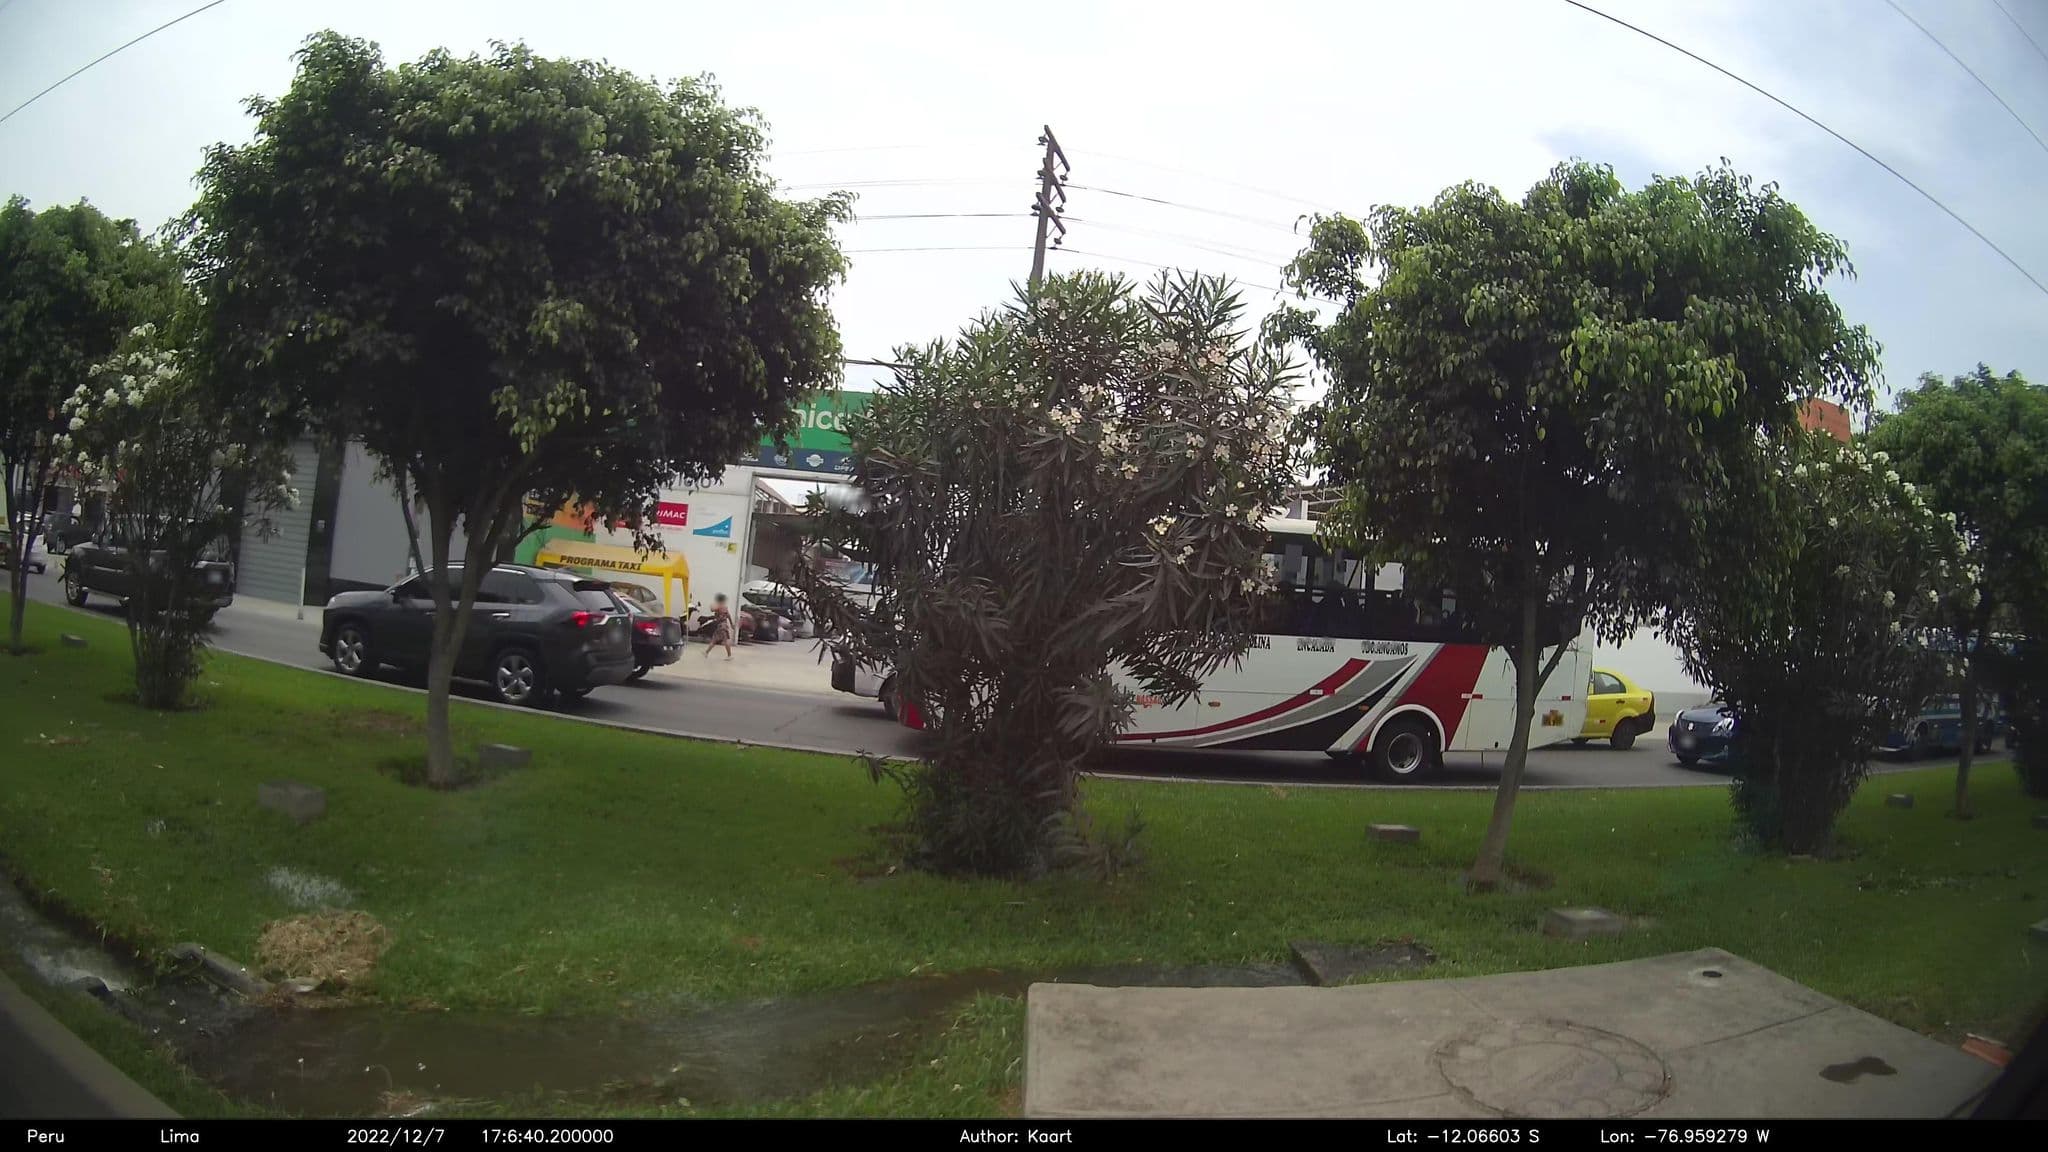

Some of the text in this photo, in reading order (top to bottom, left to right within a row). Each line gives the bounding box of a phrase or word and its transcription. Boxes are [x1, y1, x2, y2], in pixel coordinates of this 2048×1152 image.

[656, 509, 687, 519] IMAC
[559, 554, 643, 571] PROGRAMA TAXI
